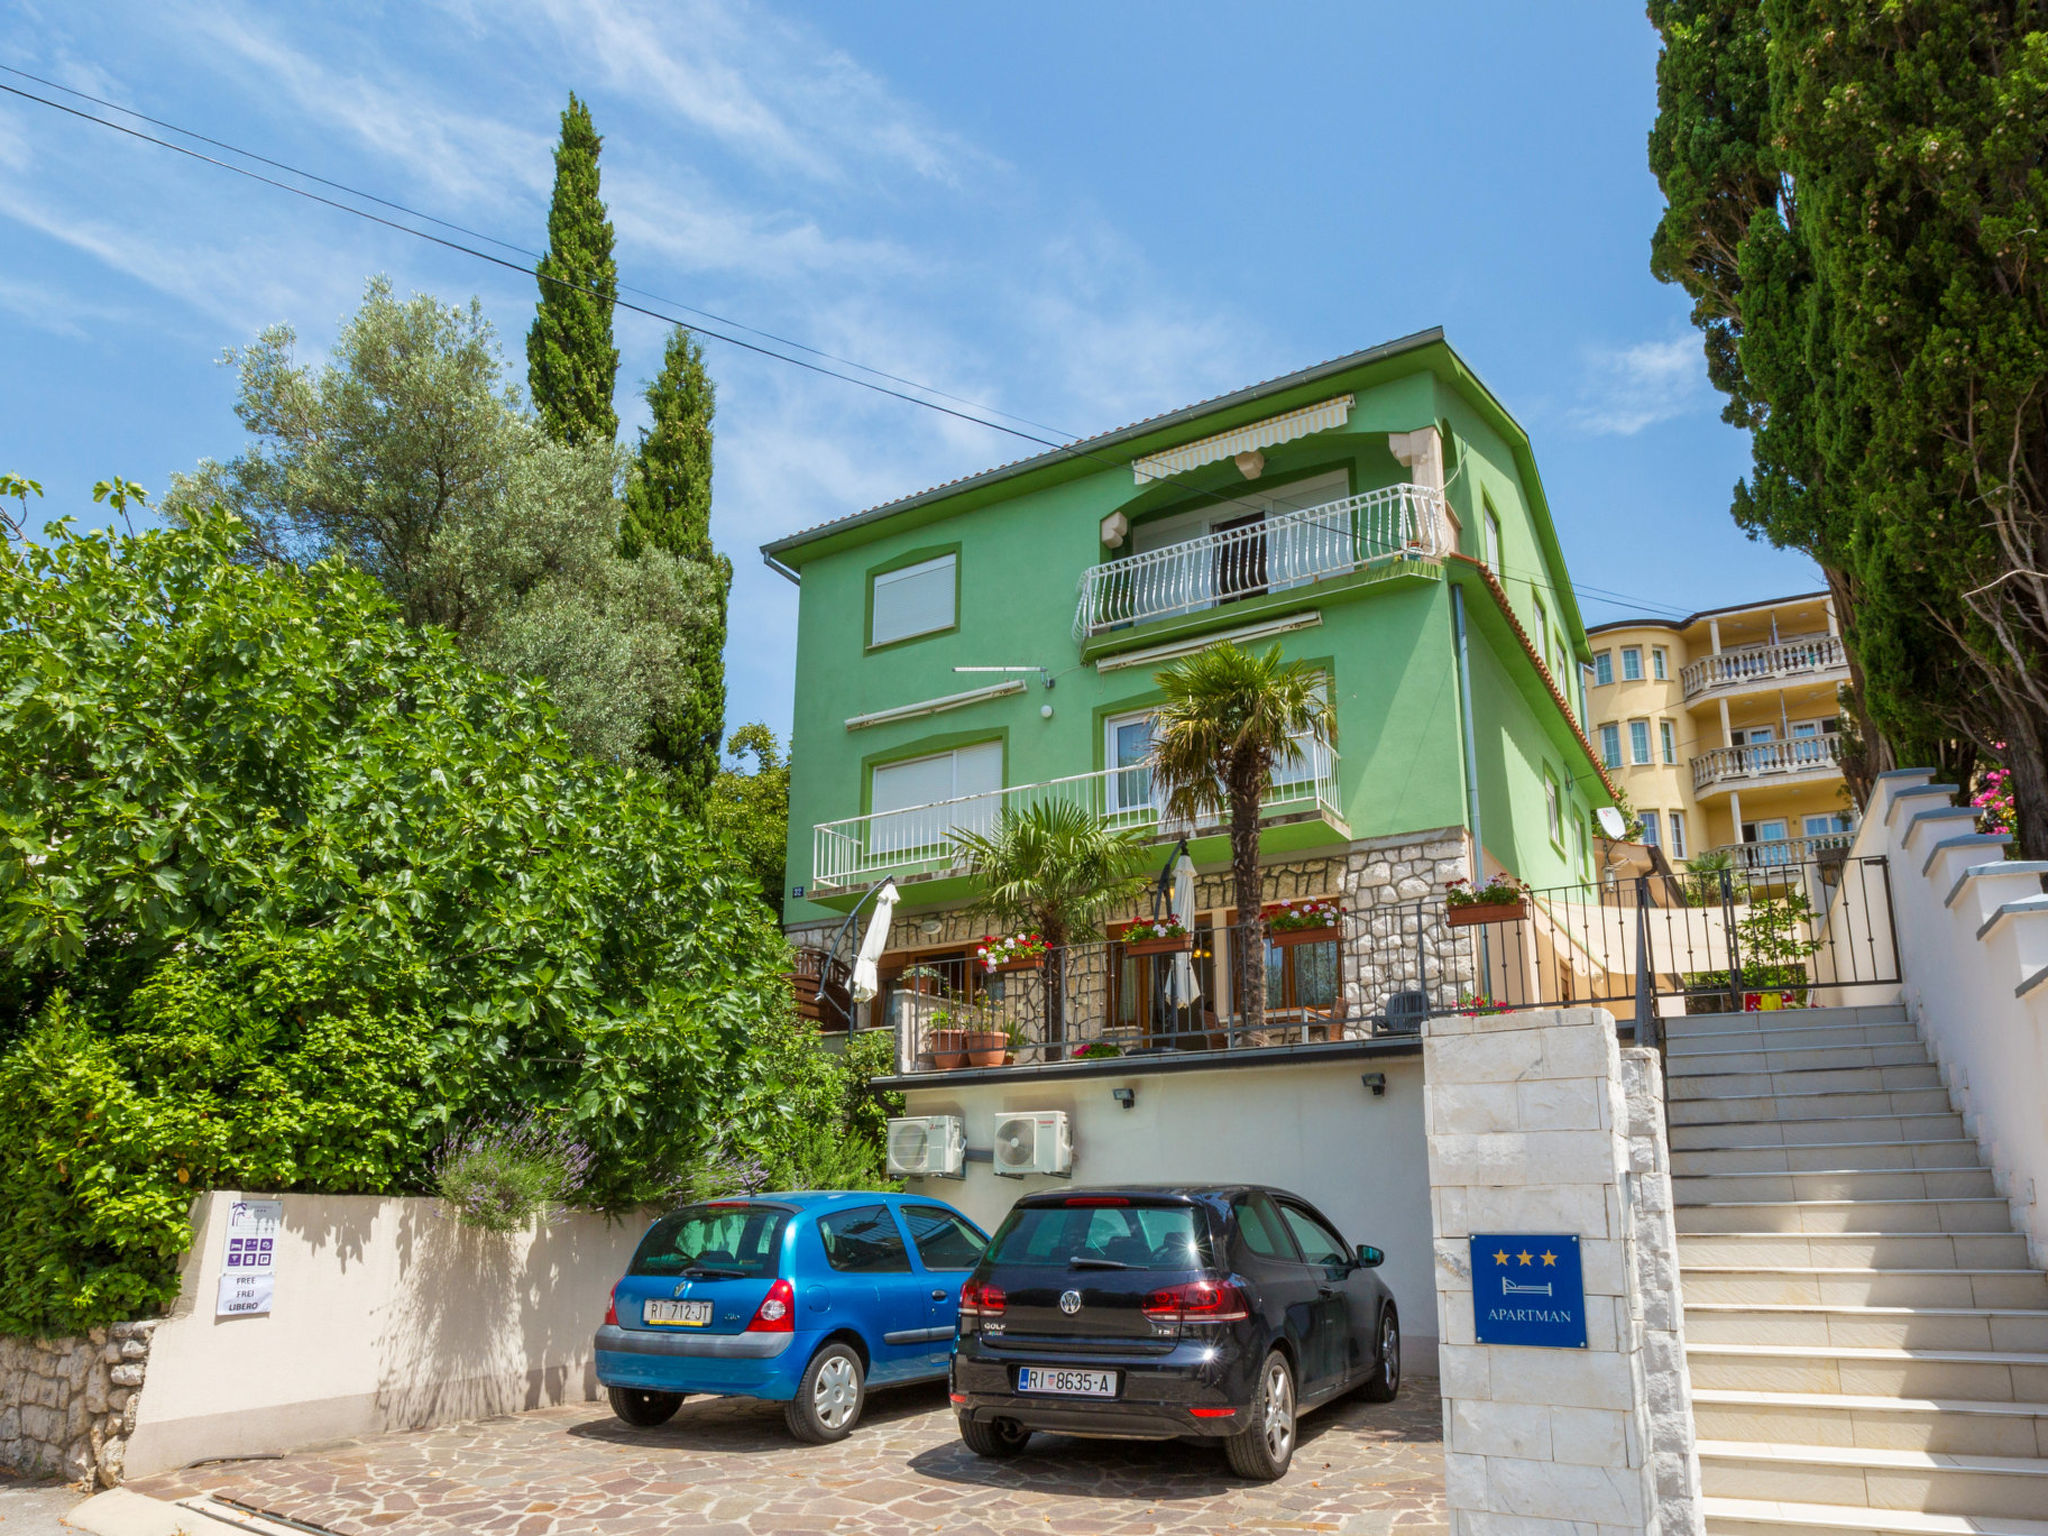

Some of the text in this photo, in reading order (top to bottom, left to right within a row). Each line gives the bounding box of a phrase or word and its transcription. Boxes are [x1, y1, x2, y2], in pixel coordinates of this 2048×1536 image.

[236, 1277, 256, 1285] FREE
[236, 1290, 255, 1298] FREI
[229, 1302, 258, 1312] LIBERO
[651, 1303, 663, 1319] RI
[1488, 1308, 1571, 1322] APARTMAN
[984, 1322, 1006, 1330] GOLF
[1029, 1371, 1109, 1392] RI 8635-A
